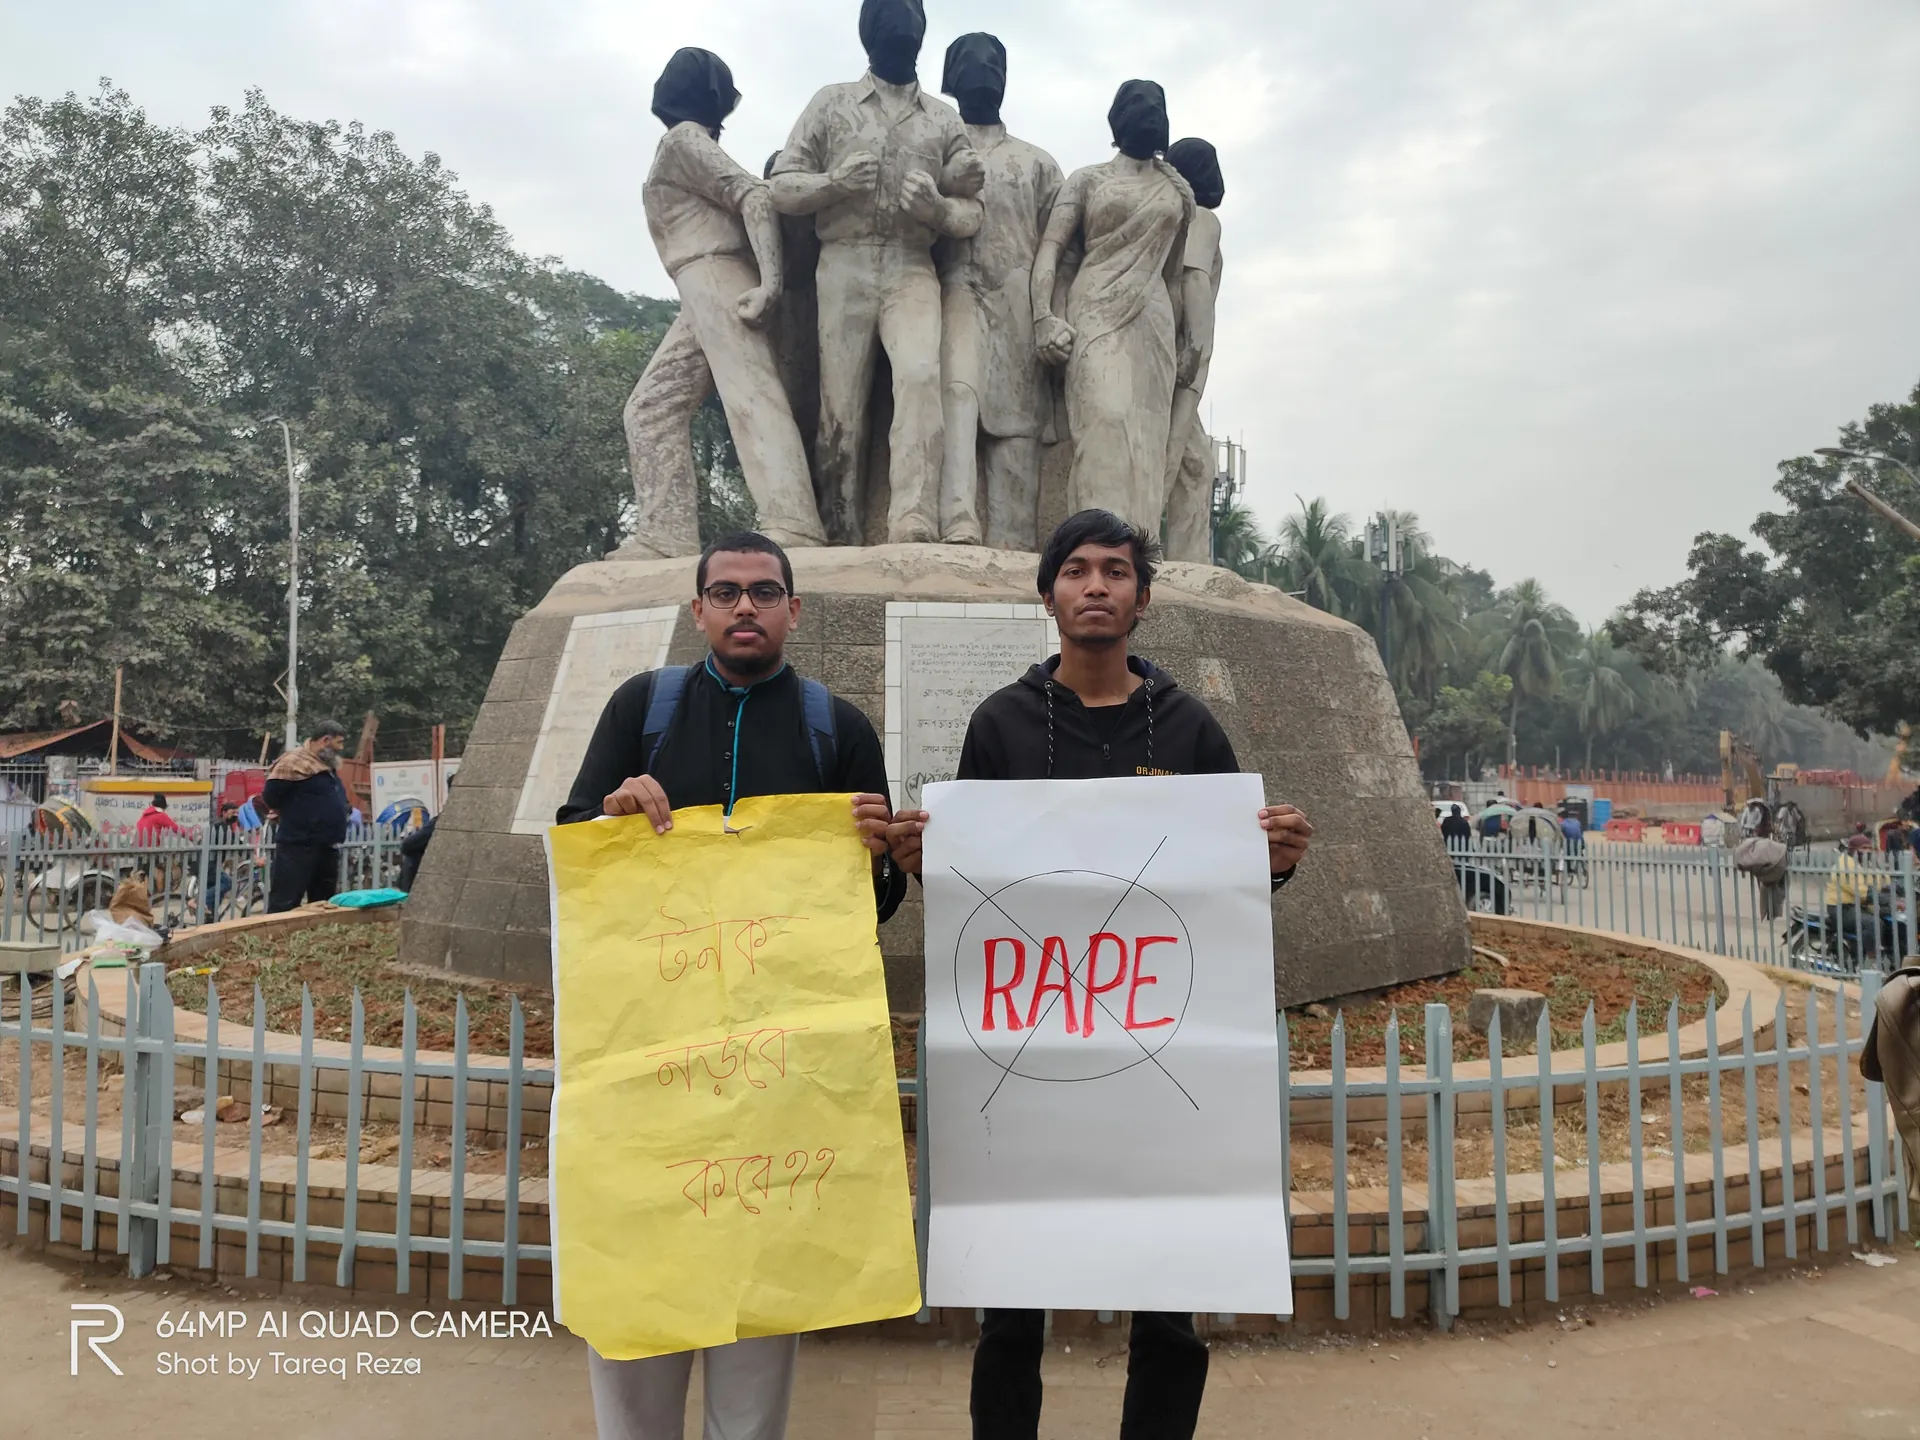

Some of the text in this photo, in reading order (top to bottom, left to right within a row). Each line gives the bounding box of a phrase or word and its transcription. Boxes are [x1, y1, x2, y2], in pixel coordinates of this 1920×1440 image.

[637, 906, 810, 982] টনক
[981, 932, 1178, 1038] RAPE
[645, 1027, 810, 1096] নড়বে
